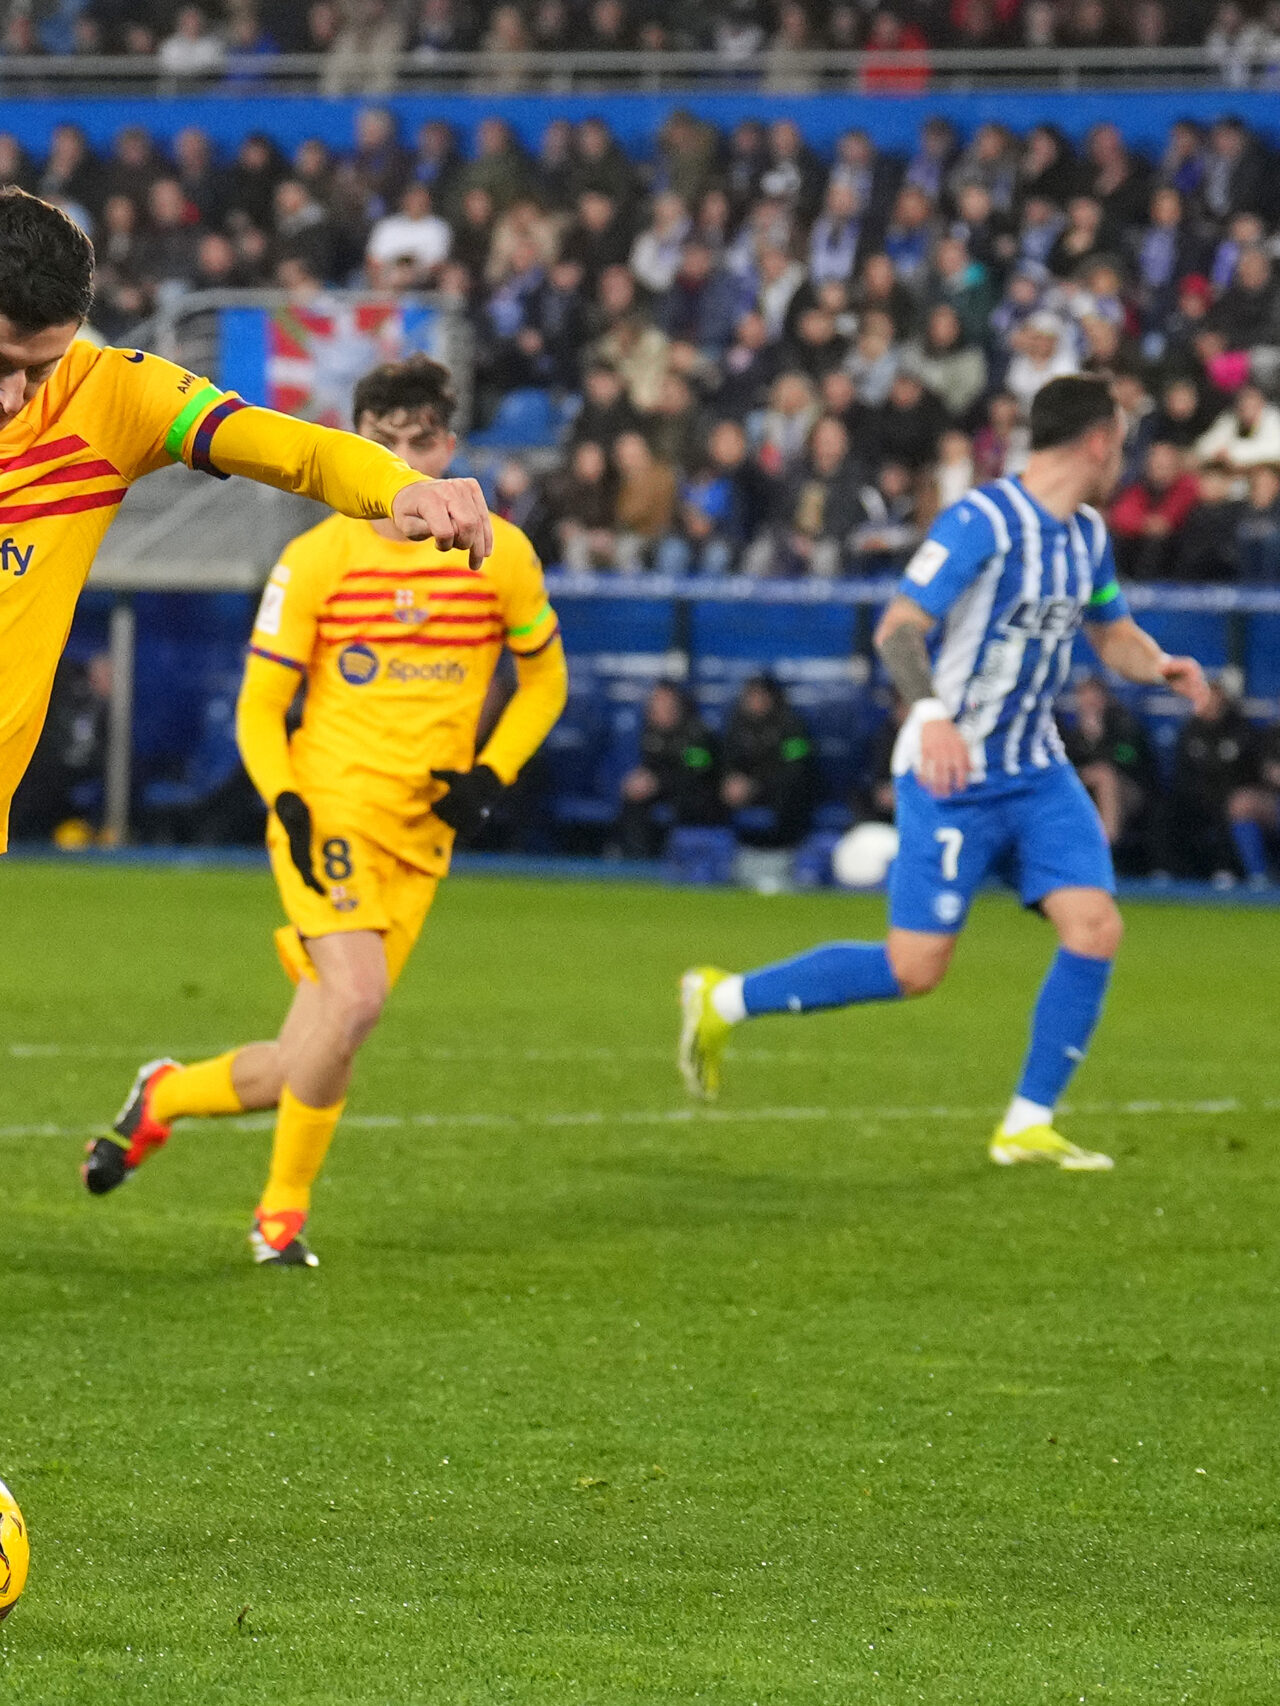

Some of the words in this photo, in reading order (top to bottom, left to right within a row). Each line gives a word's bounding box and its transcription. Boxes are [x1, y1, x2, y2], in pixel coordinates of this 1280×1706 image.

[387, 657, 468, 685] Spotify
[323, 837, 352, 880] 8
[934, 827, 964, 881] 7
